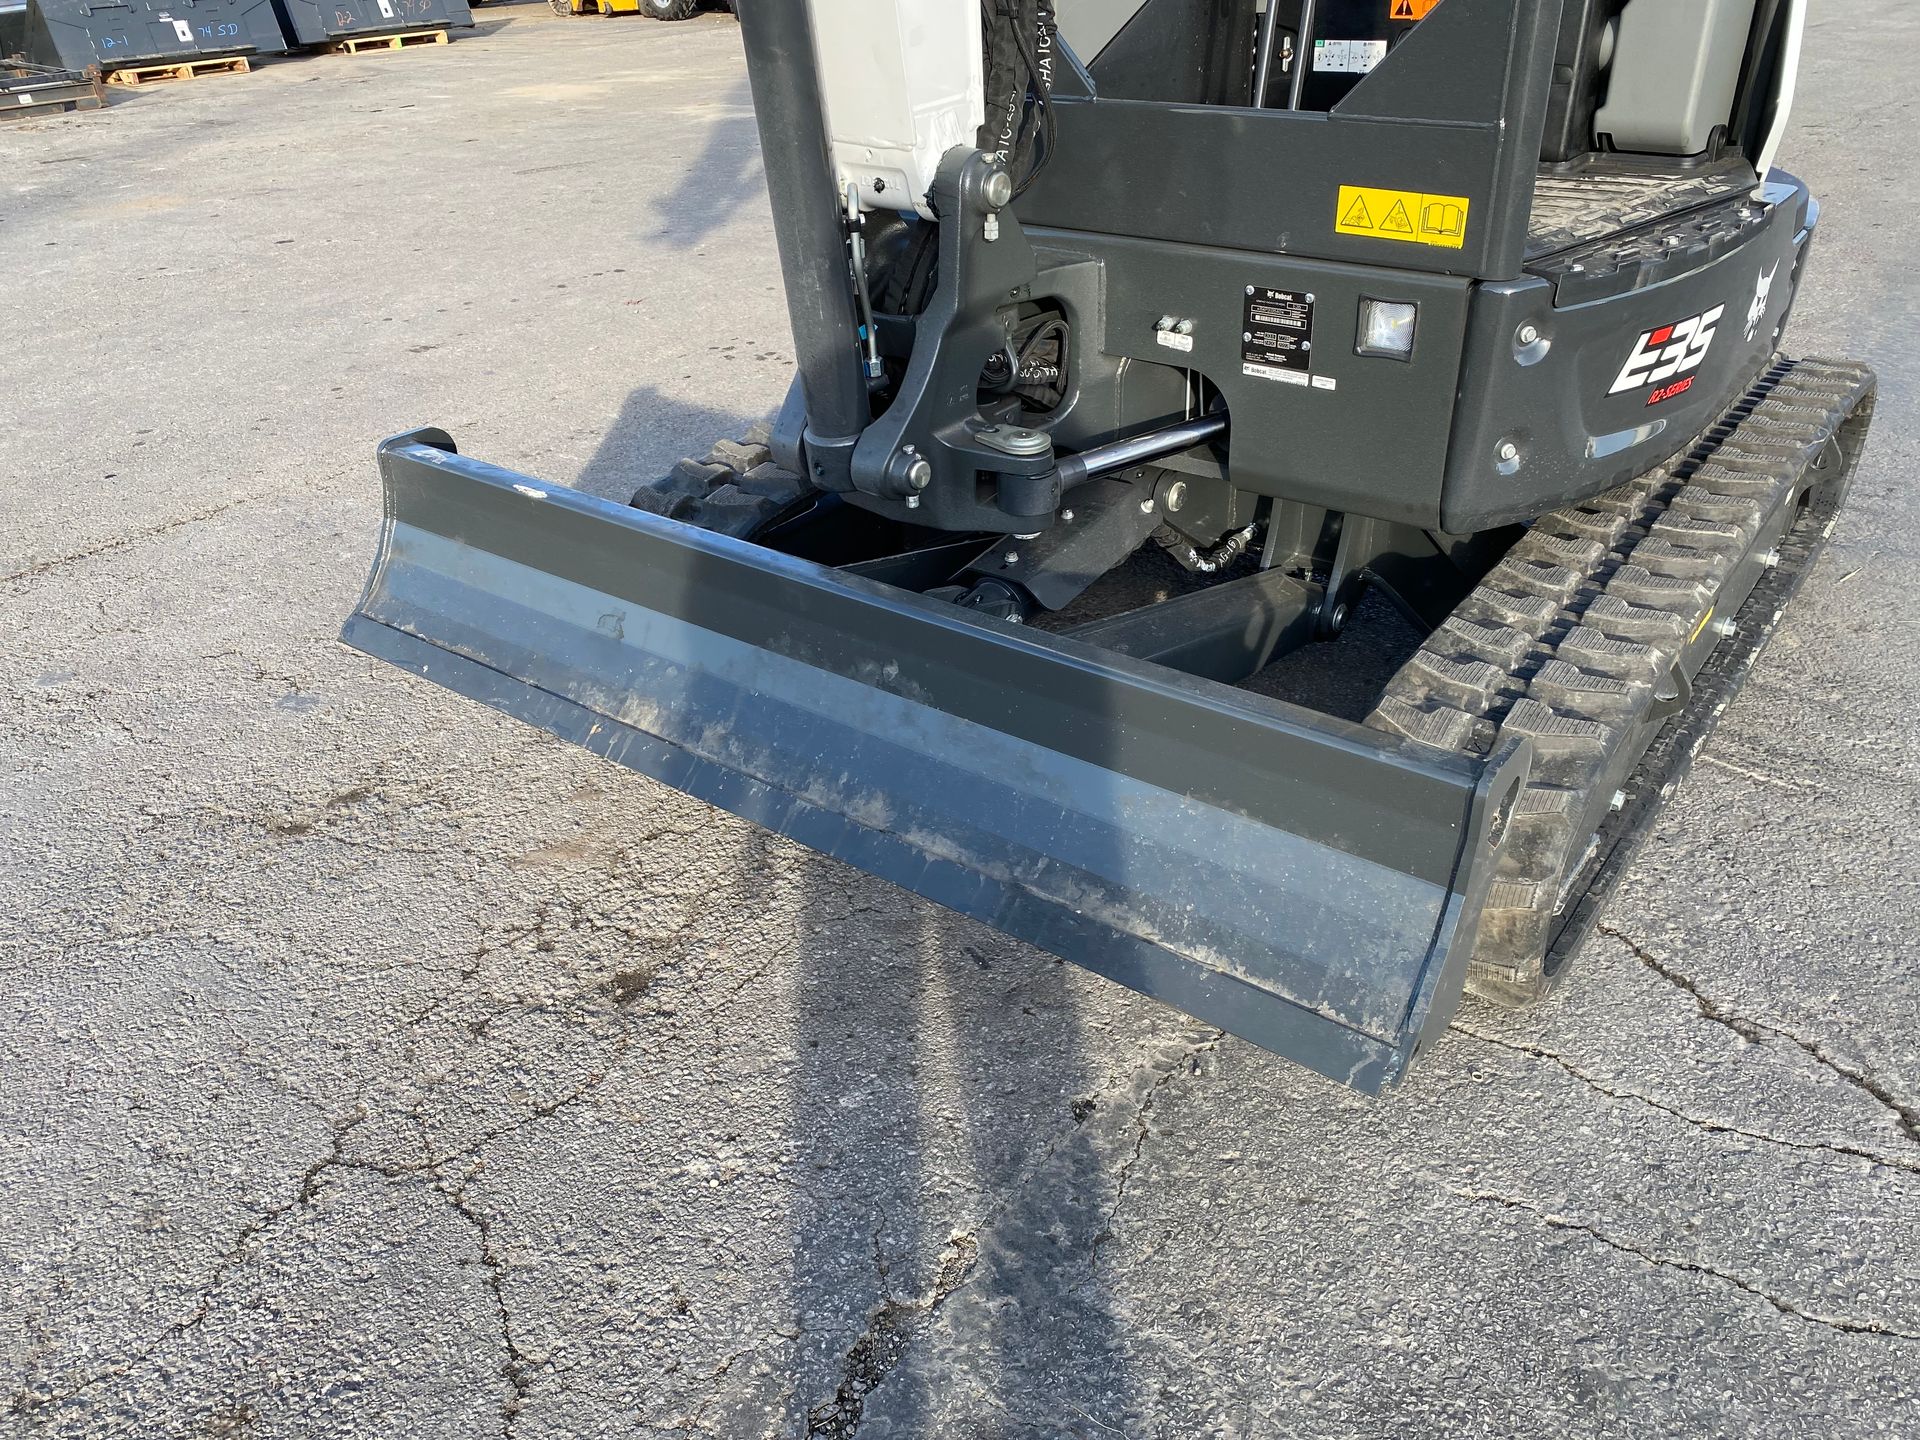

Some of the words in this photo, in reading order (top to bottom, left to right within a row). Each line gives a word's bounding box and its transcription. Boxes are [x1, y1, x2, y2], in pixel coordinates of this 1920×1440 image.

[197, 25, 212, 38] 74
[217, 23, 238, 36] SD
[101, 35, 129, 49] 12-1
[1607, 303, 1726, 394] E35
[1250, 365, 1267, 375] Bobcat
[1647, 375, 1695, 405] R2-SERIES
